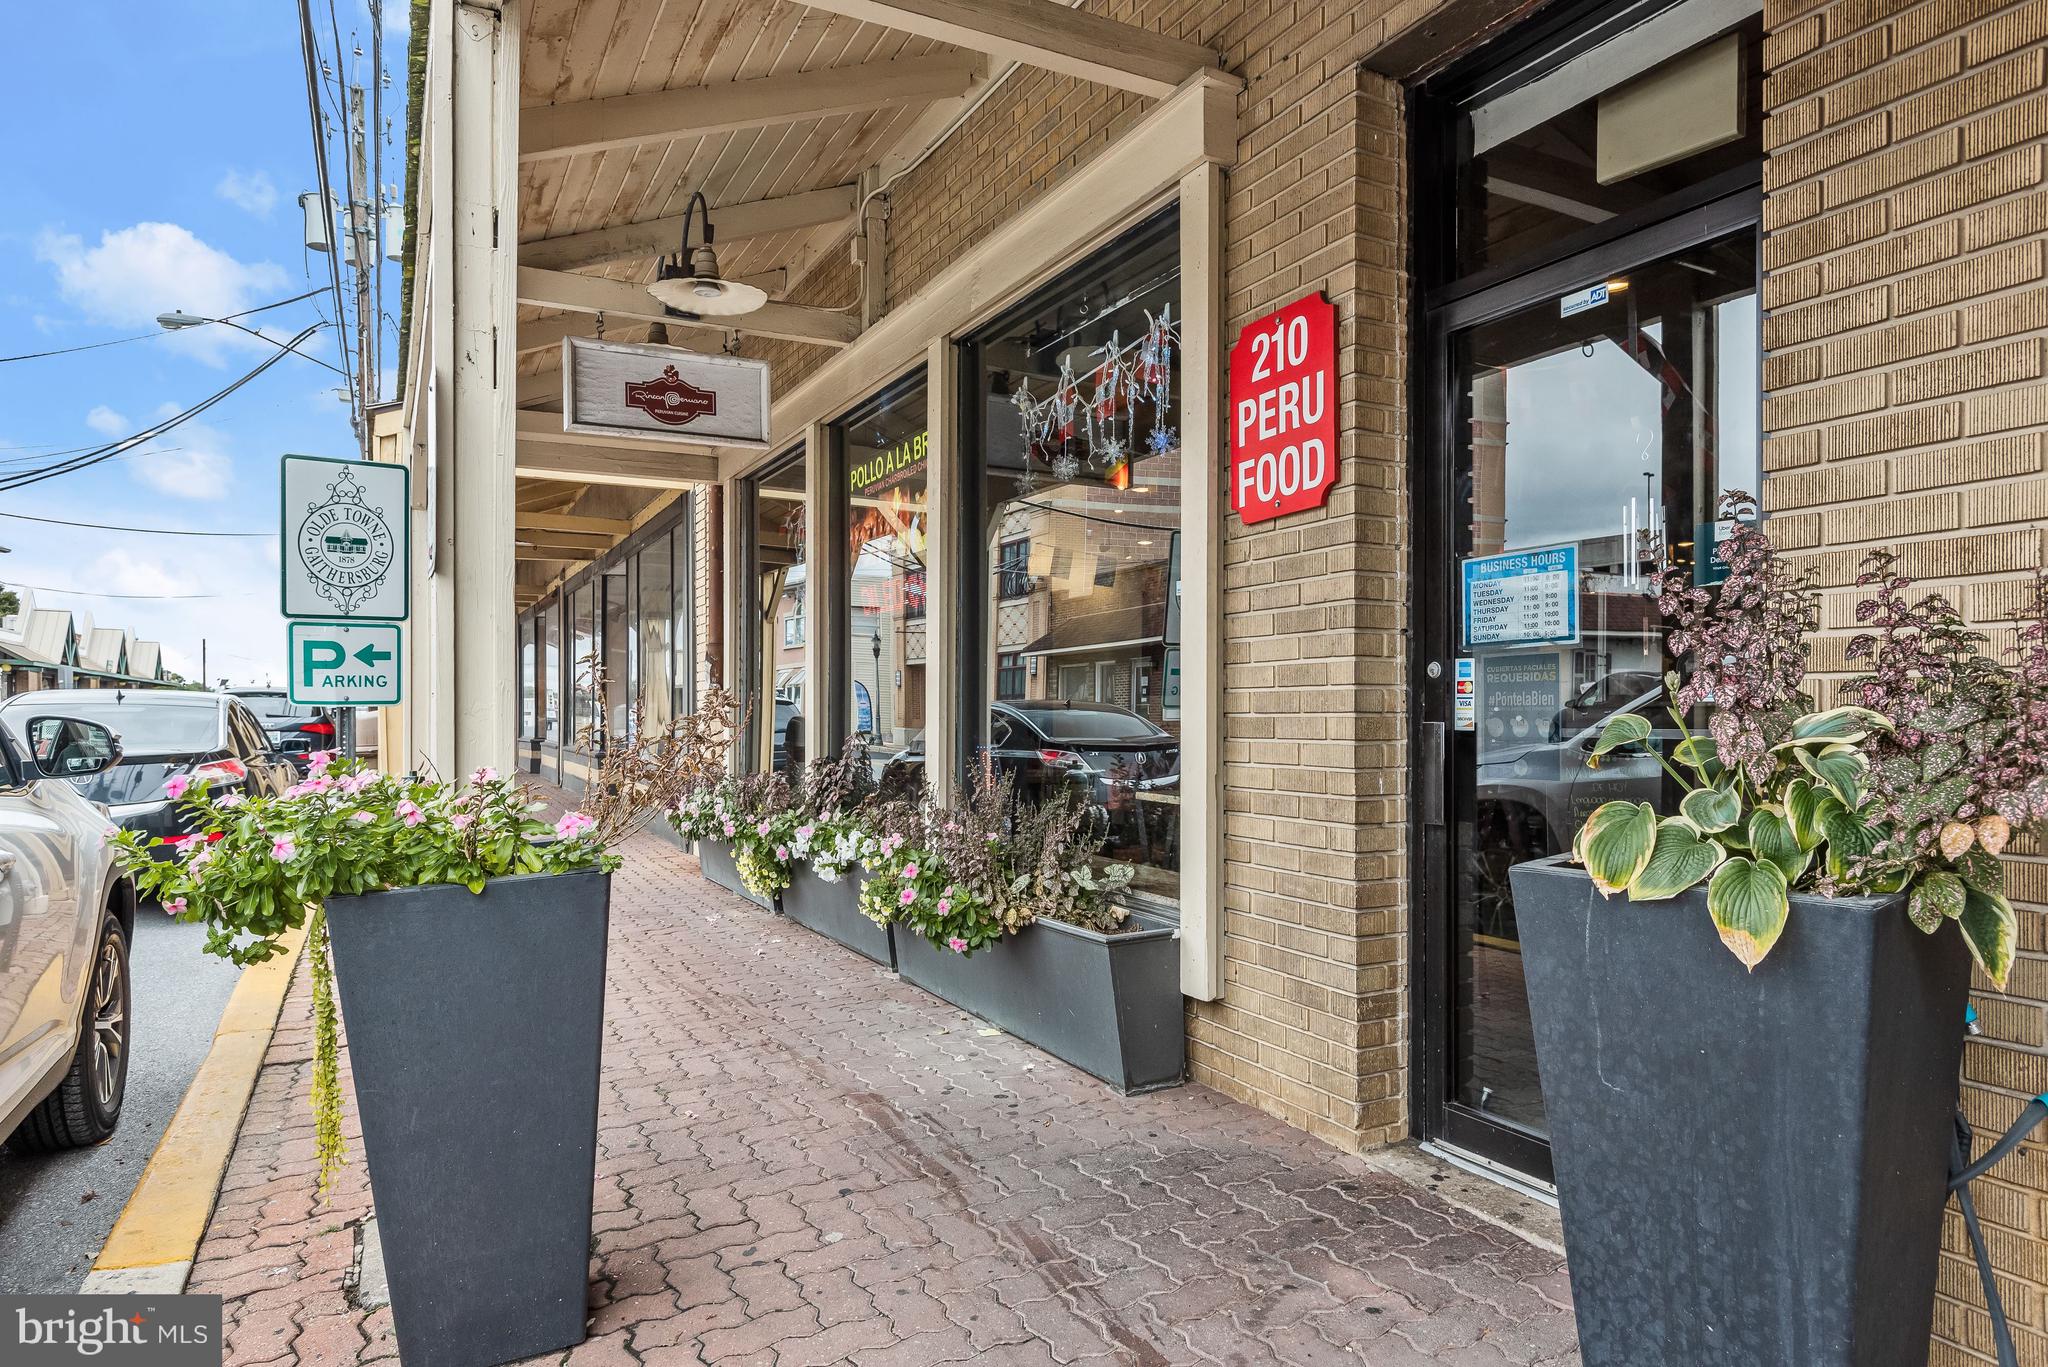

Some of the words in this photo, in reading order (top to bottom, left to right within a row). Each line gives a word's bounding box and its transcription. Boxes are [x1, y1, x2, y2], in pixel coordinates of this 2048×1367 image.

[1591, 289, 1605, 301] ADT
[1251, 315, 1308, 383] 210
[1238, 370, 1324, 448] PERU
[850, 456, 884, 492] POLLO
[886, 451, 894, 474] A
[896, 442, 911, 469] LA
[1238, 438, 1325, 508] FOOD
[307, 507, 339, 537] OLDE
[344, 507, 386, 546] TOWNE
[304, 546, 389, 585] GAITHERSBURG
[338, 556, 355, 564] 1878
[1480, 557, 1528, 573] BUSINESS
[1531, 552, 1566, 566] HOURS
[1473, 580, 1502, 589] MONDAY
[1473, 589, 1503, 598] TUESDAY
[1473, 596, 1514, 607] WEDNESDAY
[1473, 606, 1509, 616] THURSDAY
[1473, 616, 1496, 624] FRIDAY
[1473, 624, 1508, 633] SATURDAY
[1473, 633, 1500, 642] SUNDAY
[1486, 665, 1522, 673] CUBIERTAS
[1486, 672, 1556, 683] REQUERIDAS
[1488, 690, 1554, 706] #PóntelaBien
